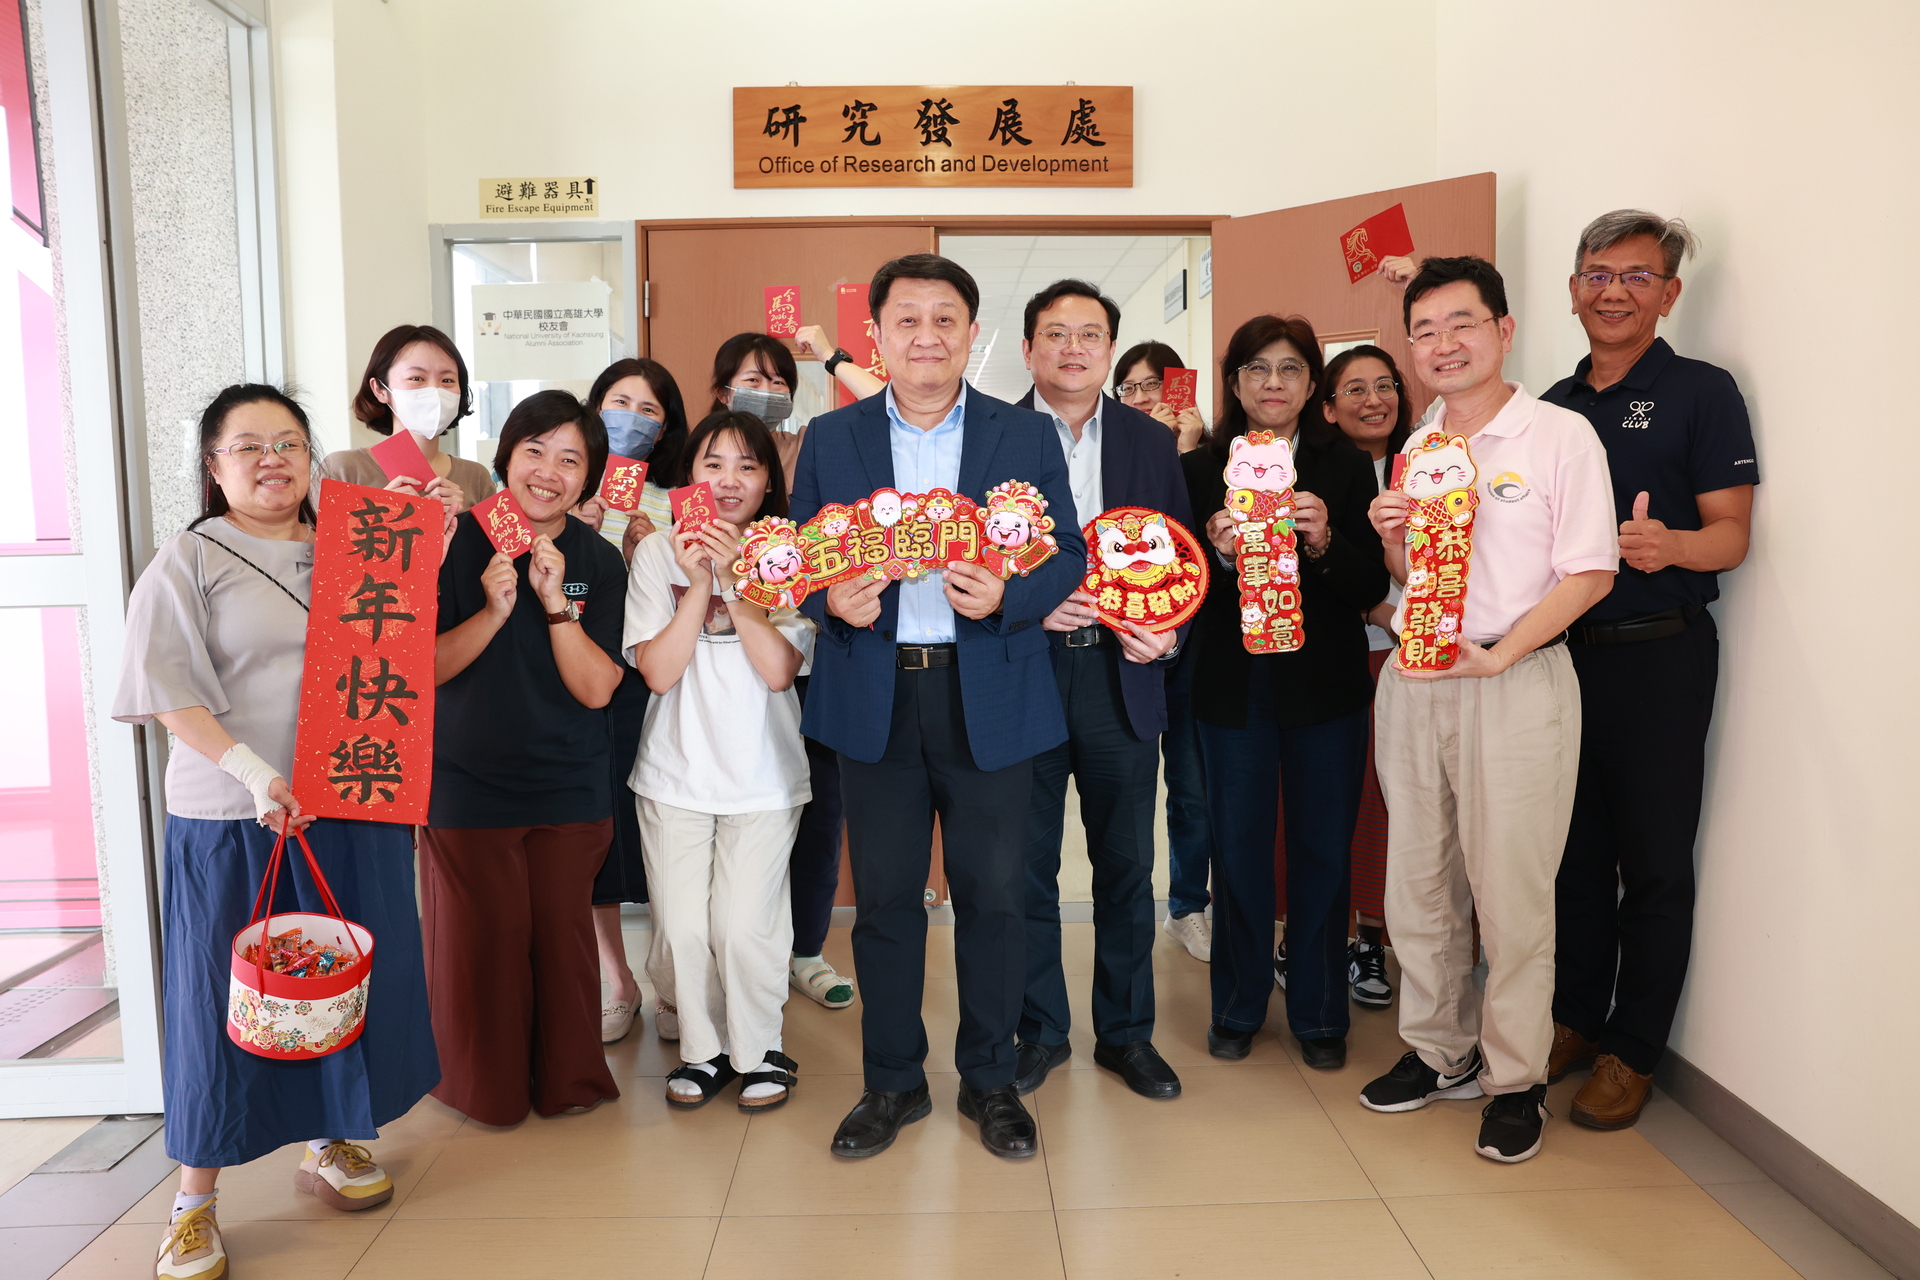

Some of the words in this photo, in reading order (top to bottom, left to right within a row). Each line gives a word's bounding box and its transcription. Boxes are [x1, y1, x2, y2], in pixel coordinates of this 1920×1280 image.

[762, 97, 1107, 147] 研究發展處
[758, 155, 815, 174] Office
[820, 155, 839, 173] of
[844, 154, 936, 173] Research
[940, 154, 977, 173] and
[982, 154, 1110, 176] Development
[495, 181, 584, 201] 避難器具
[486, 204, 504, 213] Fire
[508, 204, 540, 214] Escape
[543, 203, 594, 214] Equipment
[503, 308, 604, 320] 中華民國國立高雄大學
[504, 332, 529, 340] National
[531, 332, 562, 341] University
[563, 331, 571, 339] of
[572, 330, 604, 339] Kaohsiung
[538, 321, 569, 331] 校友會
[548, 338, 584, 346] Association
[1621, 420, 1649, 429] CLUB
[807, 520, 979, 581] 五福臨門
[1238, 521, 1299, 650] 萬事如意
[1099, 579, 1198, 619] 恭喜發財
[1405, 527, 1470, 668] 恭喜發財
[327, 497, 424, 805] 新年快樂
